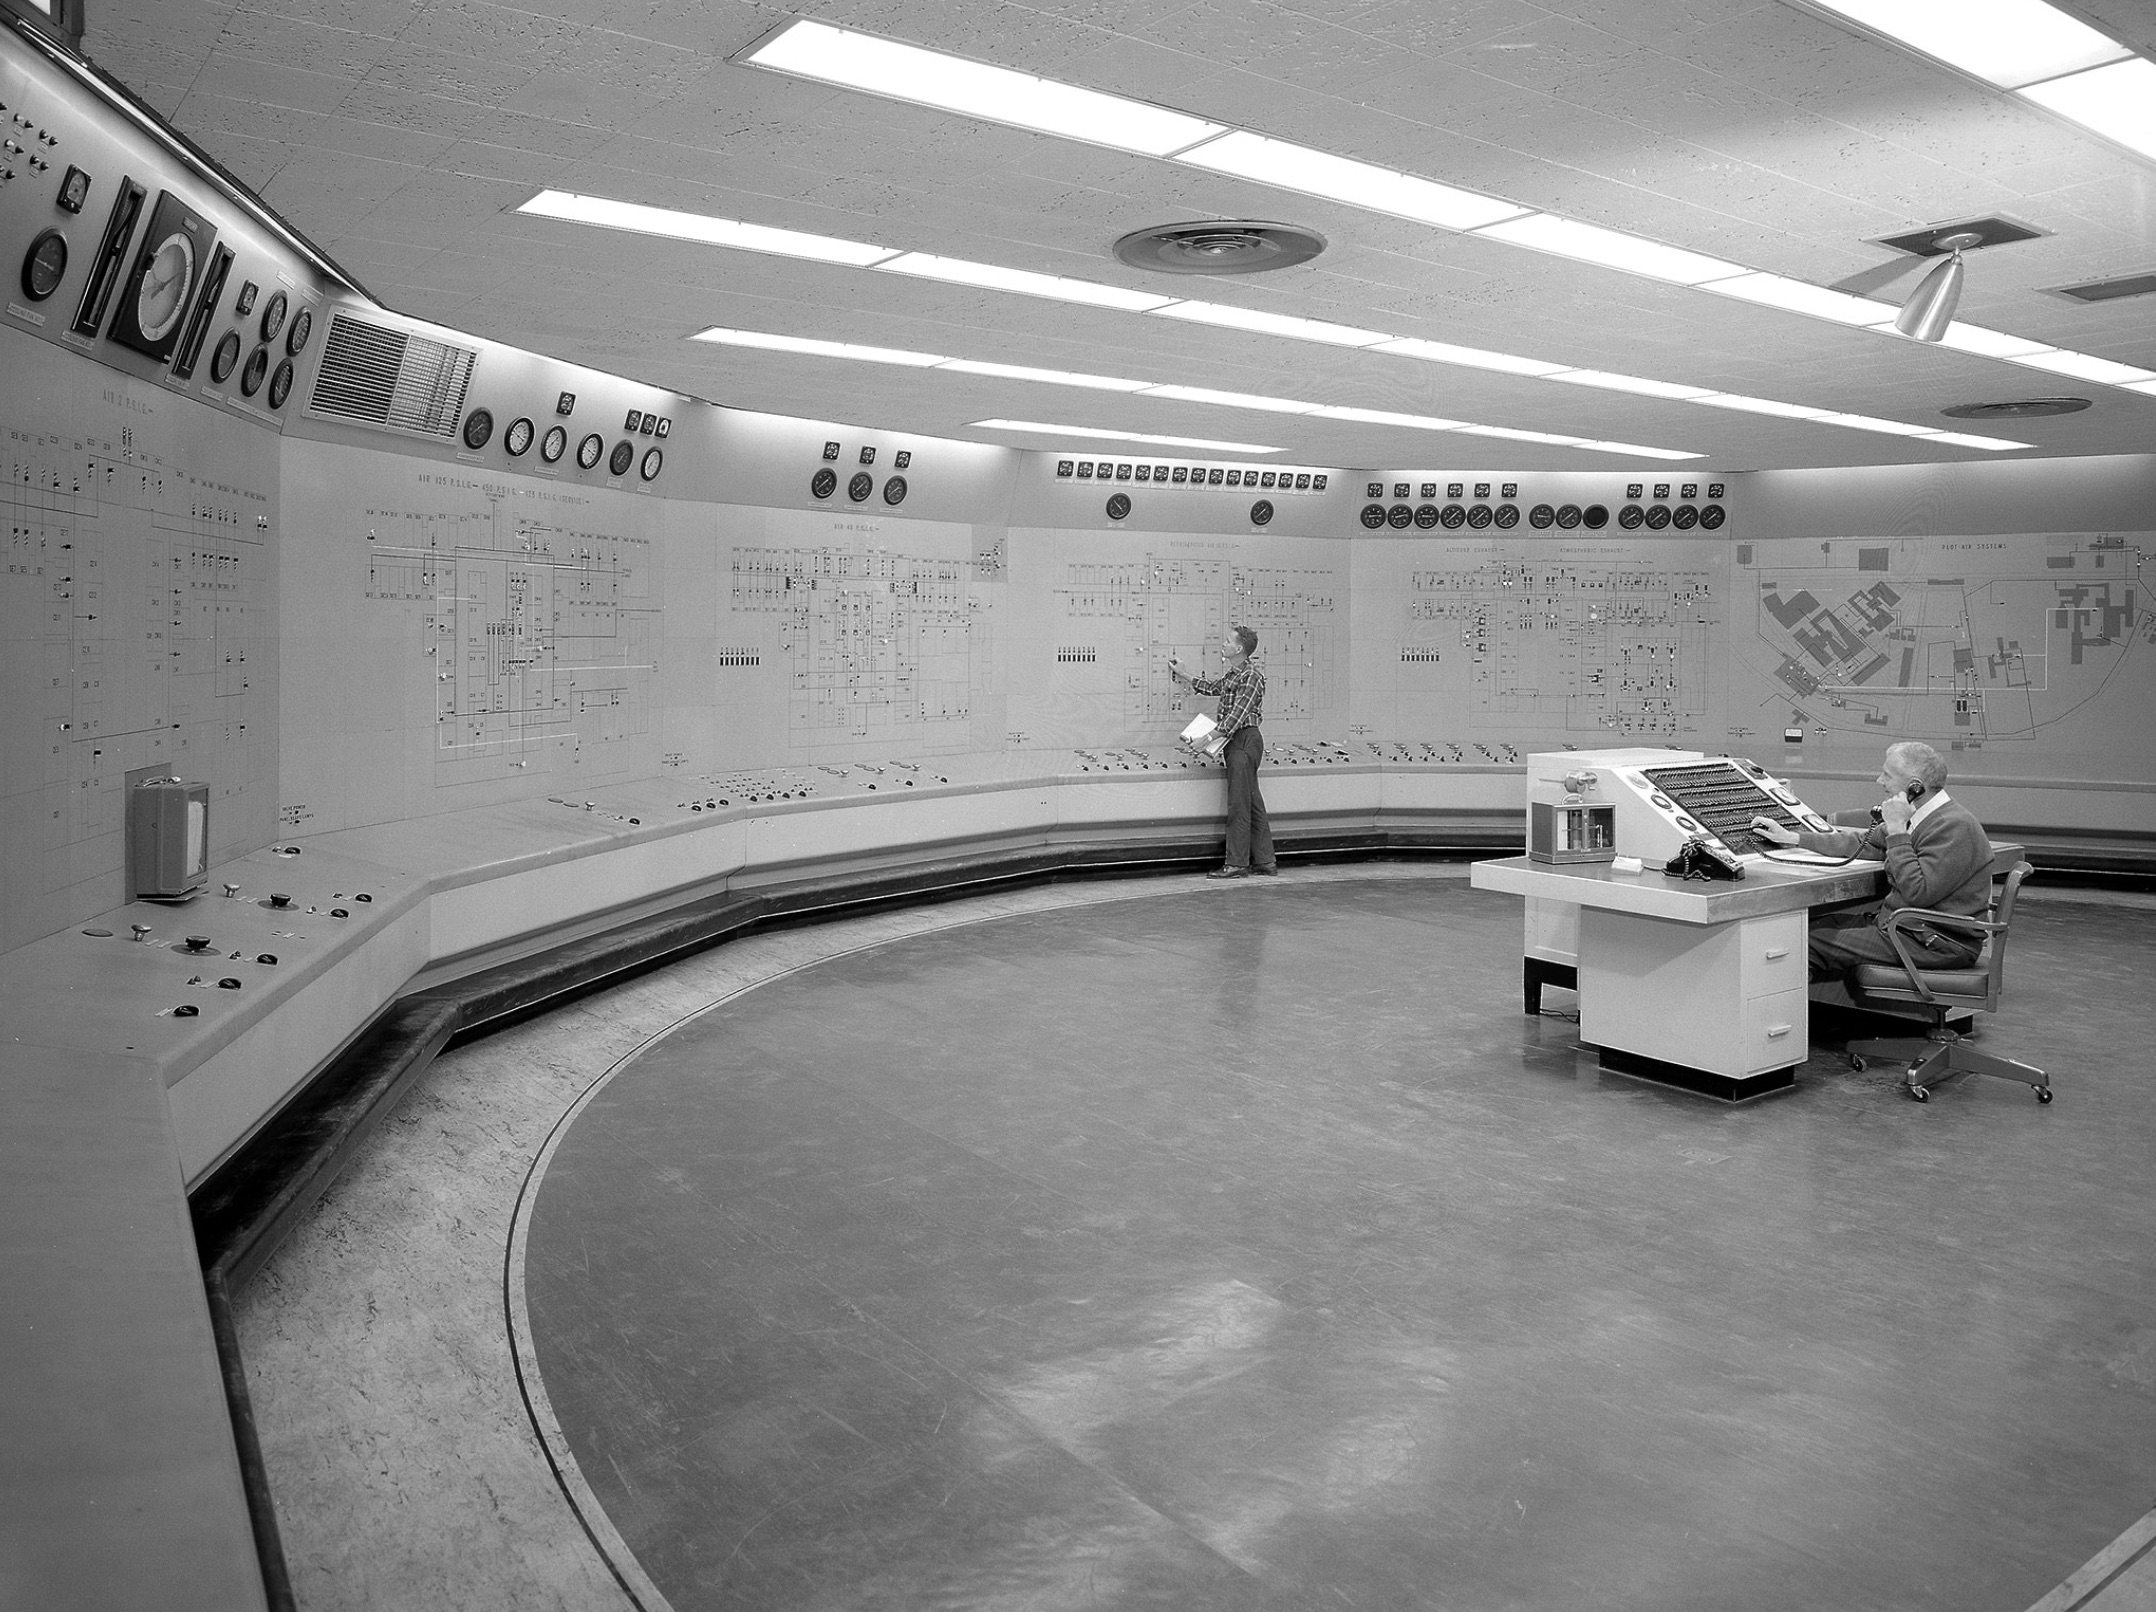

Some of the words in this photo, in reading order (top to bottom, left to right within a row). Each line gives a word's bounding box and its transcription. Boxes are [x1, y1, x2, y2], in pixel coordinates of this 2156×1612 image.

[418, 474, 430, 483] AIR
[435, 476, 447, 486] 125
[482, 484, 493, 493] 450
